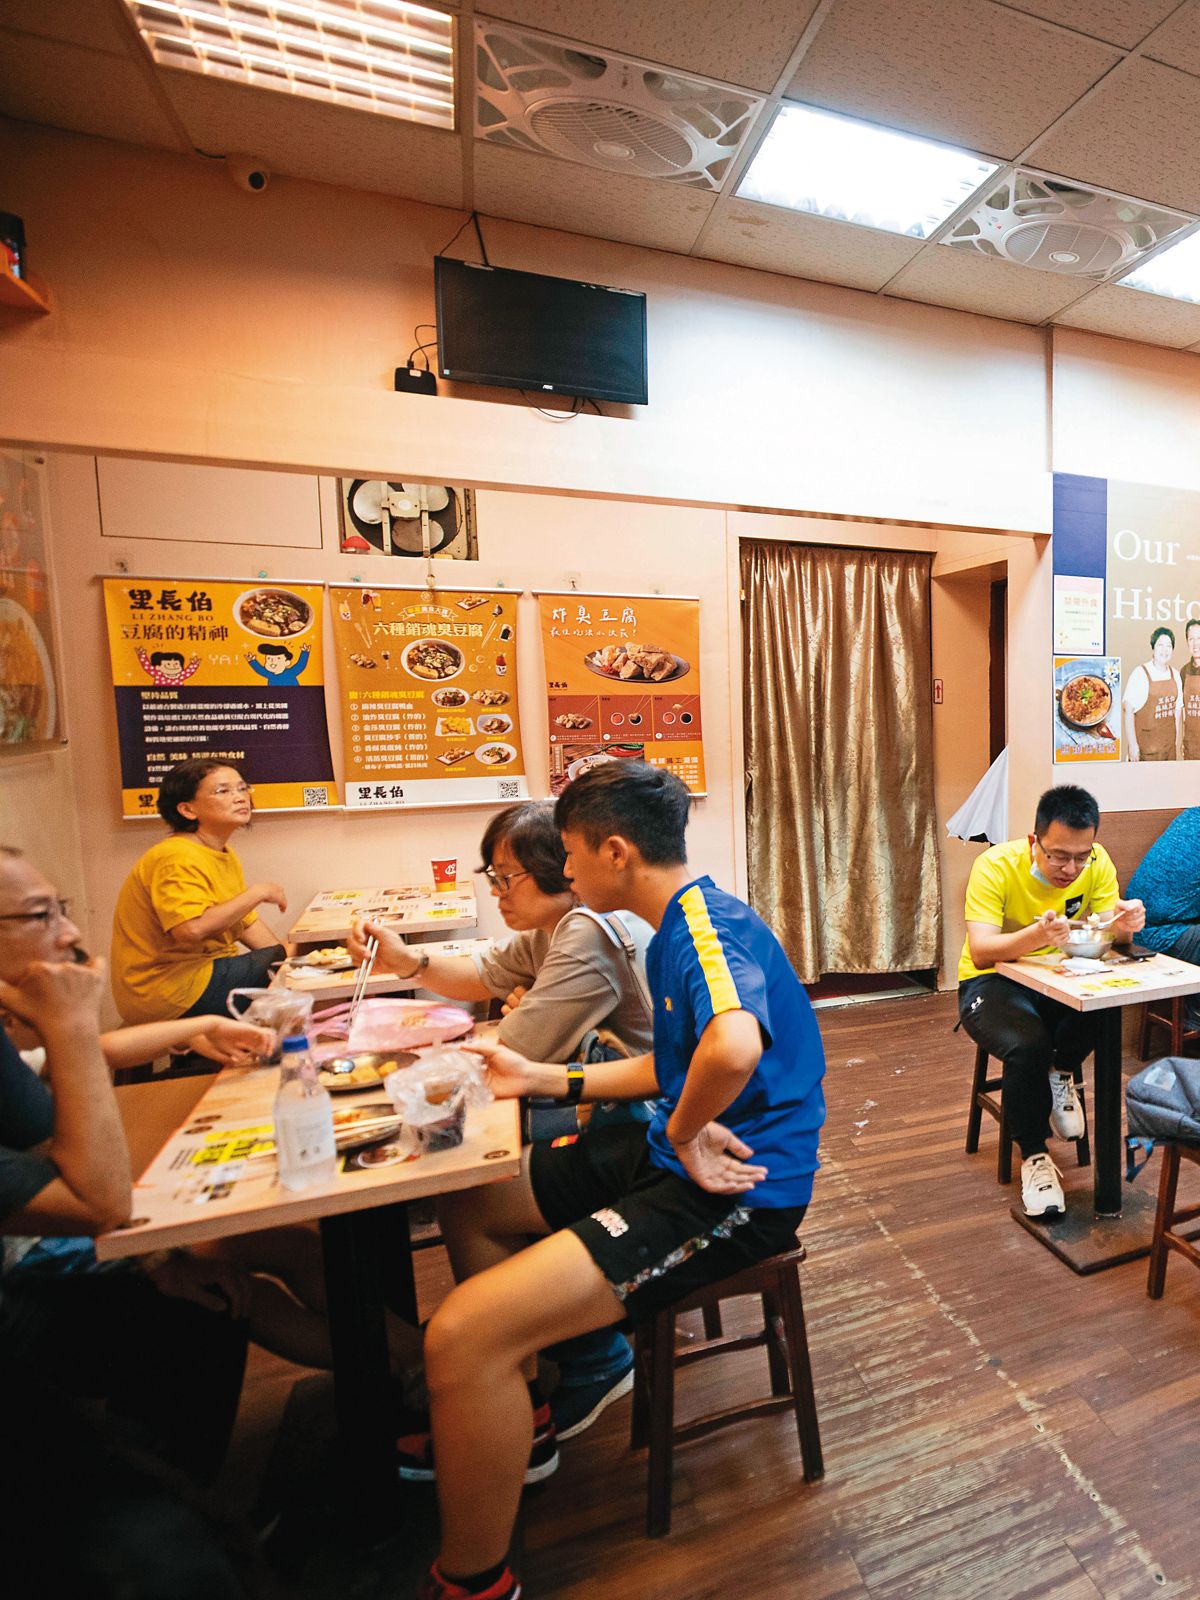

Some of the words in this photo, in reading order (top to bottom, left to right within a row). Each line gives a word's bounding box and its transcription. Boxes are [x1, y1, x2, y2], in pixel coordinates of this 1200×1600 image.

[1113, 529, 1181, 566] Our
[129, 589, 212, 611] 里長伯
[552, 605, 637, 627] 炸臭豆腐
[121, 623, 228, 641] 豆腐的精神
[373, 621, 483, 637] 六種銷魂臭豆腐
[358, 786, 404, 799] 里長伯
